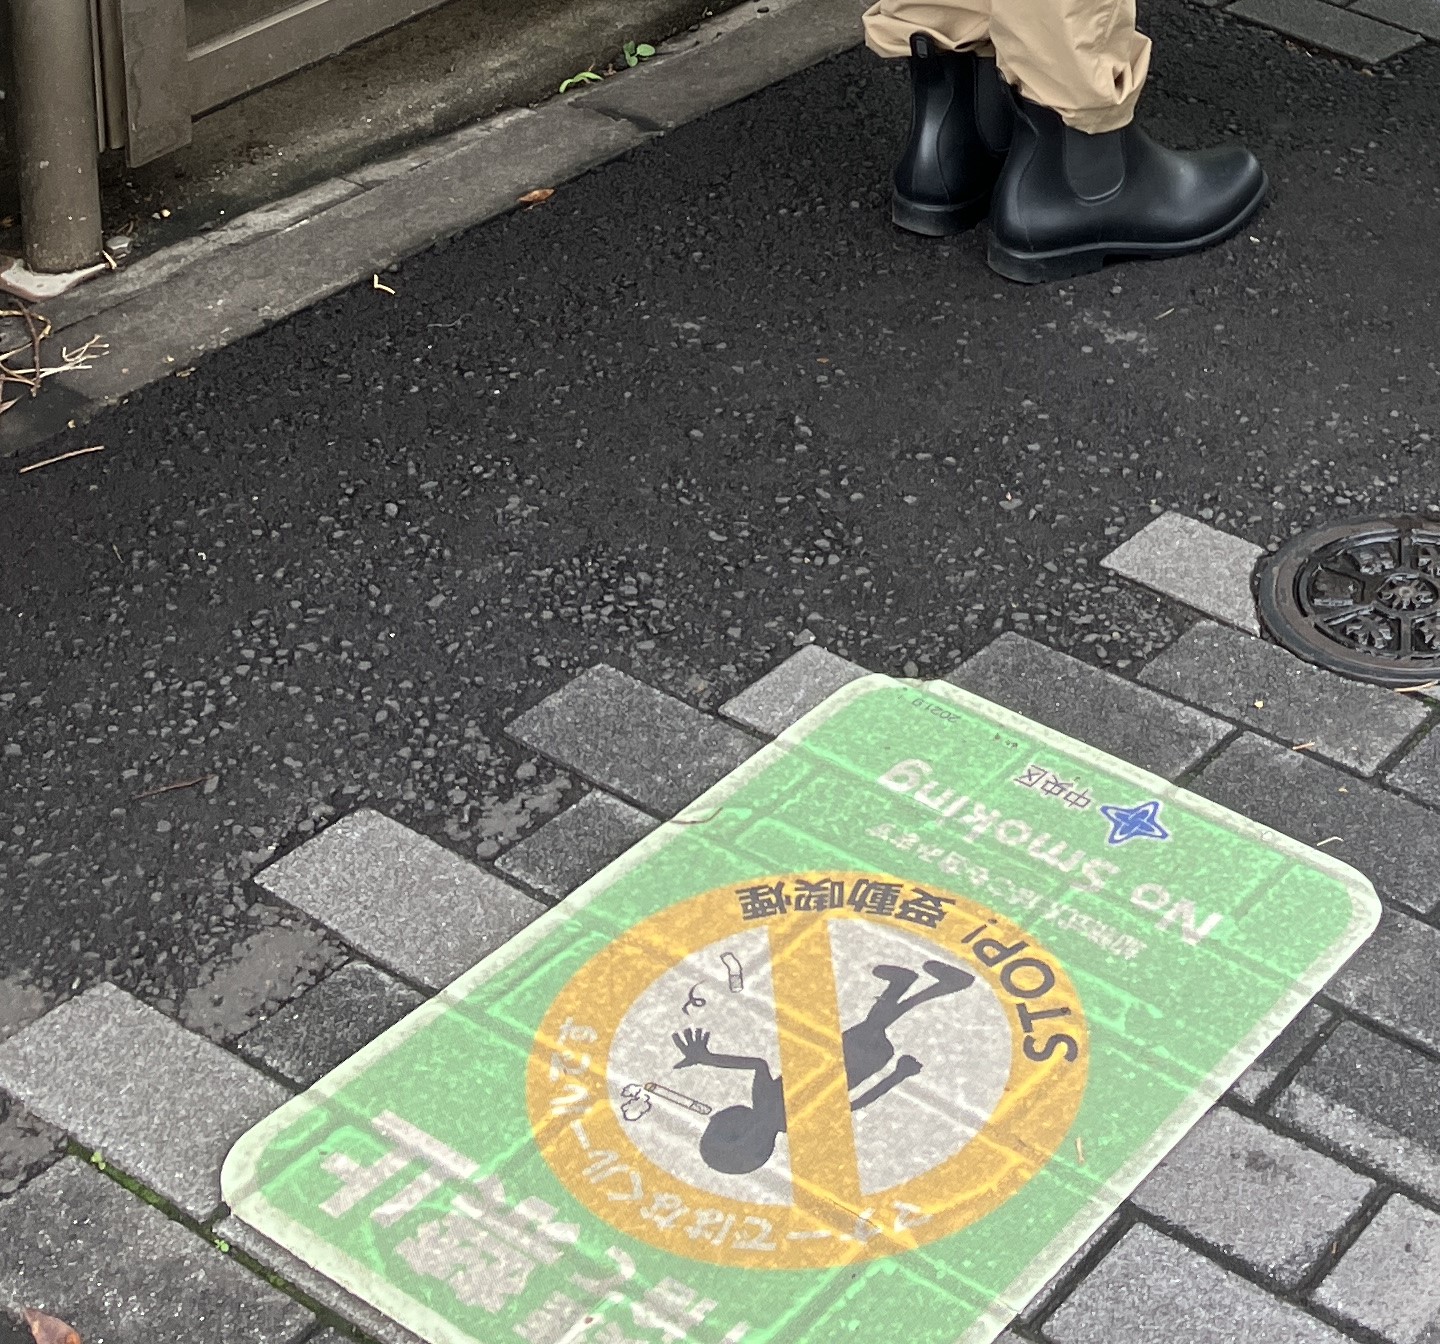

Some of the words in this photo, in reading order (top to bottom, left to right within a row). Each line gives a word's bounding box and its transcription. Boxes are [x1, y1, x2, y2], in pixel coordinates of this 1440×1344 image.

[877, 757, 1121, 894] Smoking
[1017, 763, 1092, 810] 中央区
[736, 877, 956, 930] 受動喫煙
[1129, 882, 1224, 946] No
[961, 919, 1079, 1063] STOP!
[318, 1109, 580, 1314] 禁止
